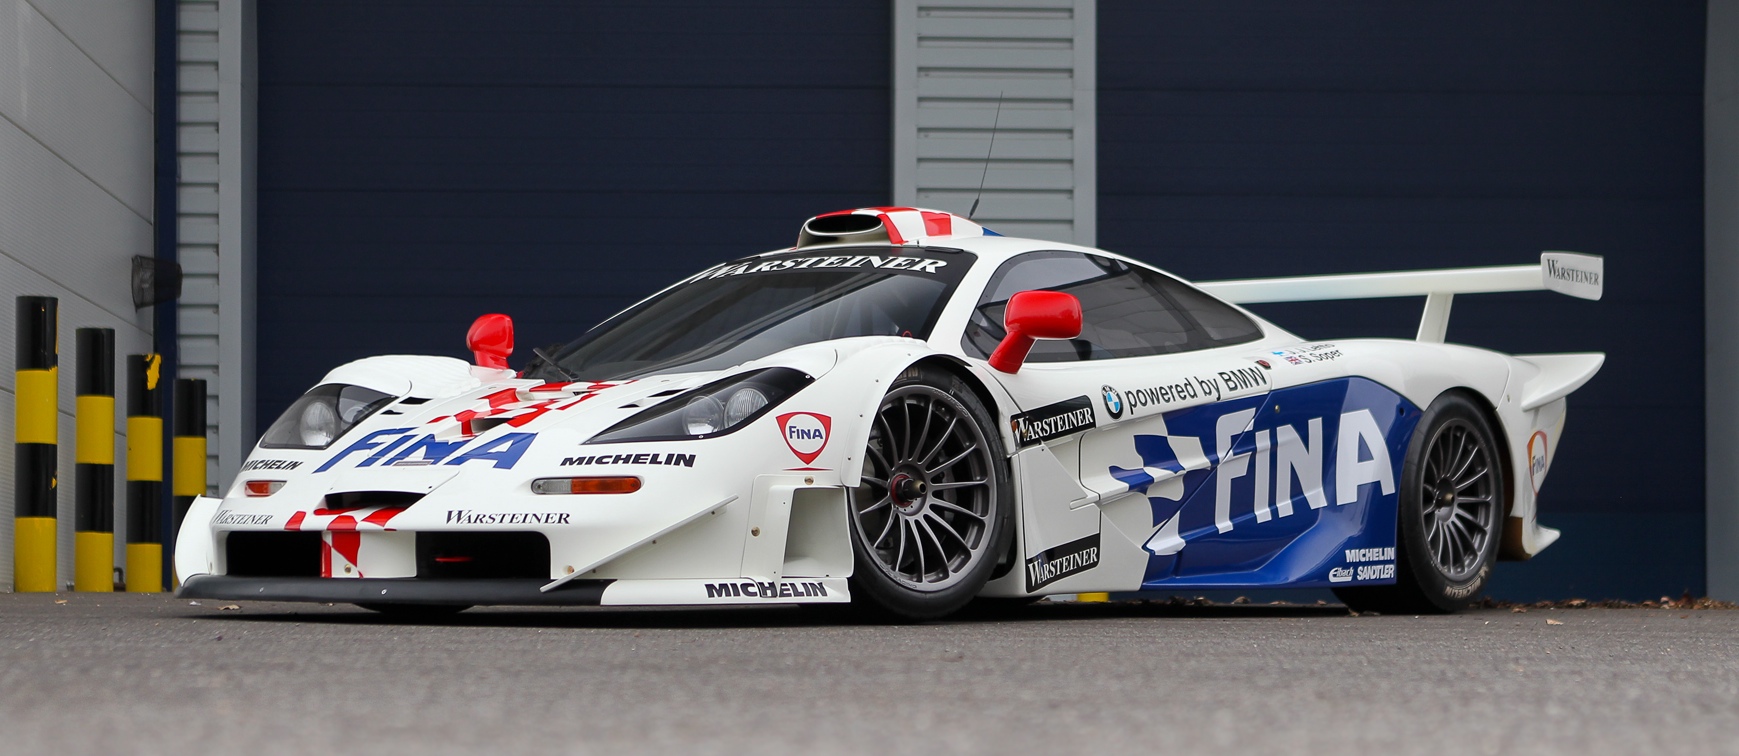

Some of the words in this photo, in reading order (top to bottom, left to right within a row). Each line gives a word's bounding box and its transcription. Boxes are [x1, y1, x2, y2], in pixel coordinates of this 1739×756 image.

[690, 255, 948, 284] WARSTEINER
[1547, 259, 1600, 285] WARSTEINER
[1124, 377, 1198, 415] powered
[1194, 375, 1221, 401] by
[1217, 365, 1268, 392] BMW
[788, 425, 824, 440] FINA
[1010, 407, 1094, 443] WARSTEINER
[312, 427, 539, 475] FINA
[560, 453, 696, 468] MICHELIN
[240, 460, 304, 472] MICHELIN
[1215, 408, 1396, 534] FINA
[445, 510, 571, 525] WARSTEINER
[1345, 547, 1395, 563] MICHELIN
[1027, 547, 1098, 587] WARSTEINER
[1357, 564, 1395, 580] SANDTLER
[704, 582, 829, 598] MICHELIN
